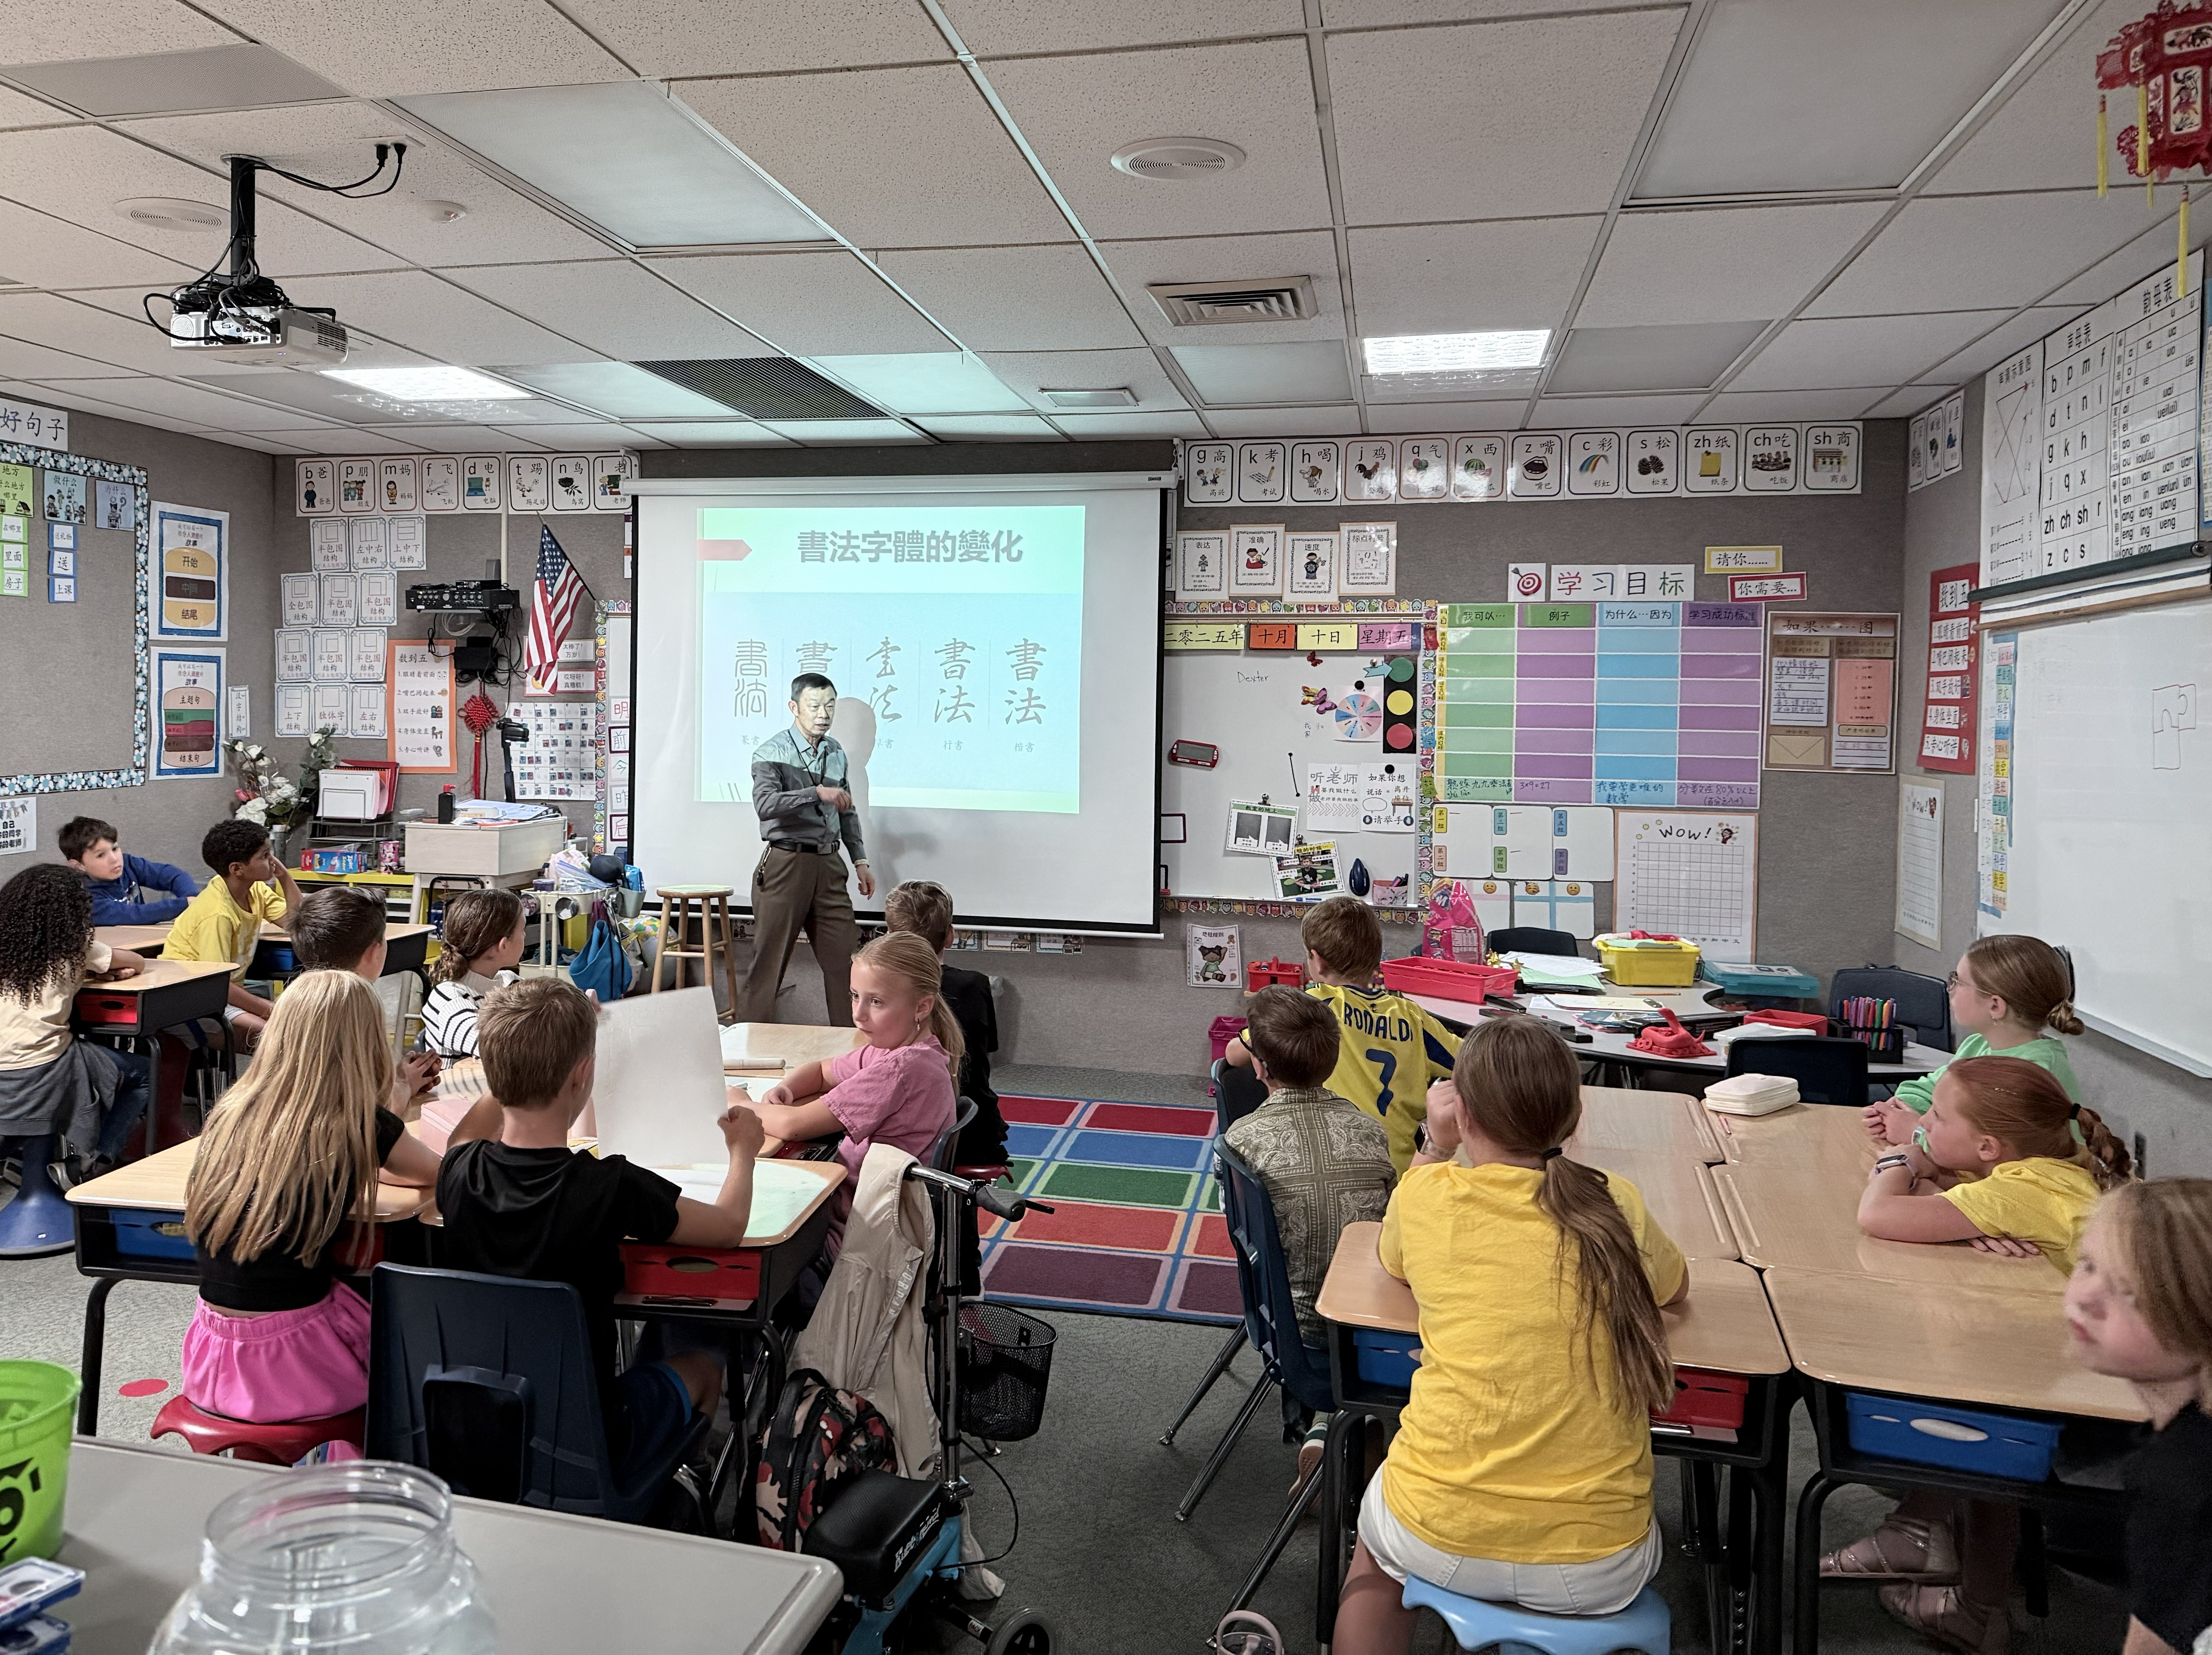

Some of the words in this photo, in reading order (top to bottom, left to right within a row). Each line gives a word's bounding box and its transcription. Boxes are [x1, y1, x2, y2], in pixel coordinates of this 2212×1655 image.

[0, 407, 65, 441] 好句子
[1583, 441, 1590, 450] c
[1598, 438, 1612, 452] 彩
[1641, 439, 1647, 449] s
[1656, 436, 1671, 449] 松
[1694, 435, 1711, 448] zh
[1715, 436, 1730, 448] 纸
[1754, 433, 1771, 446] ch
[1775, 433, 1791, 447] 吃
[1814, 432, 1832, 445] sh
[1838, 432, 1851, 446] 商
[1359, 447, 1363, 461] j
[1373, 446, 1386, 461] 鸡
[1412, 446, 1420, 459] q
[1429, 445, 1441, 458] 气
[1465, 446, 1472, 454] x
[1484, 444, 1497, 455] 西
[1526, 444, 1532, 453] z
[1540, 440, 1555, 455] 嘴
[1197, 449, 1206, 463] g
[1214, 450, 1225, 463] 高
[1250, 449, 1257, 464] k
[1265, 449, 1278, 462] 考
[1302, 449, 1311, 463] h
[1318, 448, 1331, 462] 喝
[3, 465, 19, 476] 地方
[305, 467, 313, 479] b
[317, 466, 328, 479] 爸
[346, 465, 353, 478] p
[359, 467, 368, 477] 朋
[385, 465, 397, 475] m
[400, 464, 410, 476] 妈
[426, 463, 432, 476] f
[442, 464, 452, 475] 飞
[468, 462, 476, 475] d
[484, 462, 494, 474] 电
[516, 464, 522, 475] t
[530, 463, 542, 475] 踢
[559, 464, 567, 474] n
[574, 462, 583, 475] 鸟
[54, 475, 77, 487] 做什么
[106, 485, 126, 495] 为什么
[798, 530, 1023, 563] 書法字體的變化
[1249, 536, 1264, 545] 准确
[317, 544, 343, 554] 半包围
[356, 544, 383, 554] 左中右
[394, 544, 420, 553] 上中下
[4, 552, 22, 561] 里面
[182, 556, 198, 568] 开始
[58, 556, 69, 571] 送
[4, 577, 22, 589] 房子
[56, 584, 72, 595] 上课
[1557, 571, 1684, 596] 学习目标
[289, 600, 313, 610] 全包围
[329, 599, 352, 609] 半包围
[365, 597, 391, 606] 半包围
[181, 609, 198, 620] 结尾
[1549, 611, 1570, 621] 例子
[1164, 629, 1244, 646] 二零二五年
[1258, 631, 1288, 644] 十月
[1311, 631, 1340, 644] 十日
[1360, 630, 1407, 645] 星期五
[282, 654, 307, 663] 半包围
[317, 654, 343, 663] 半包围
[355, 654, 380, 663] 半包围
[398, 654, 427, 663] 数到五
[934, 638, 976, 724] 書法
[1005, 638, 1047, 725] 書法
[1237, 671, 1269, 683] Dexter
[180, 695, 200, 705] 主题句
[285, 712, 301, 720] 上下
[319, 711, 345, 720] 独体字
[360, 712, 377, 721] 左右
[615, 702, 629, 719] 明
[612, 730, 626, 750] 前
[943, 739, 964, 752] 行書
[612, 760, 628, 774] 今
[1311, 772, 1358, 785] 听老师
[1368, 773, 1405, 783] 如果你想
[1374, 816, 1403, 825] 请举手
[614, 819, 628, 837] 后
[1659, 825, 1712, 840] WOW!
[1344, 1002, 1414, 1042] RONALD
[1366, 1049, 1397, 1116] 7
